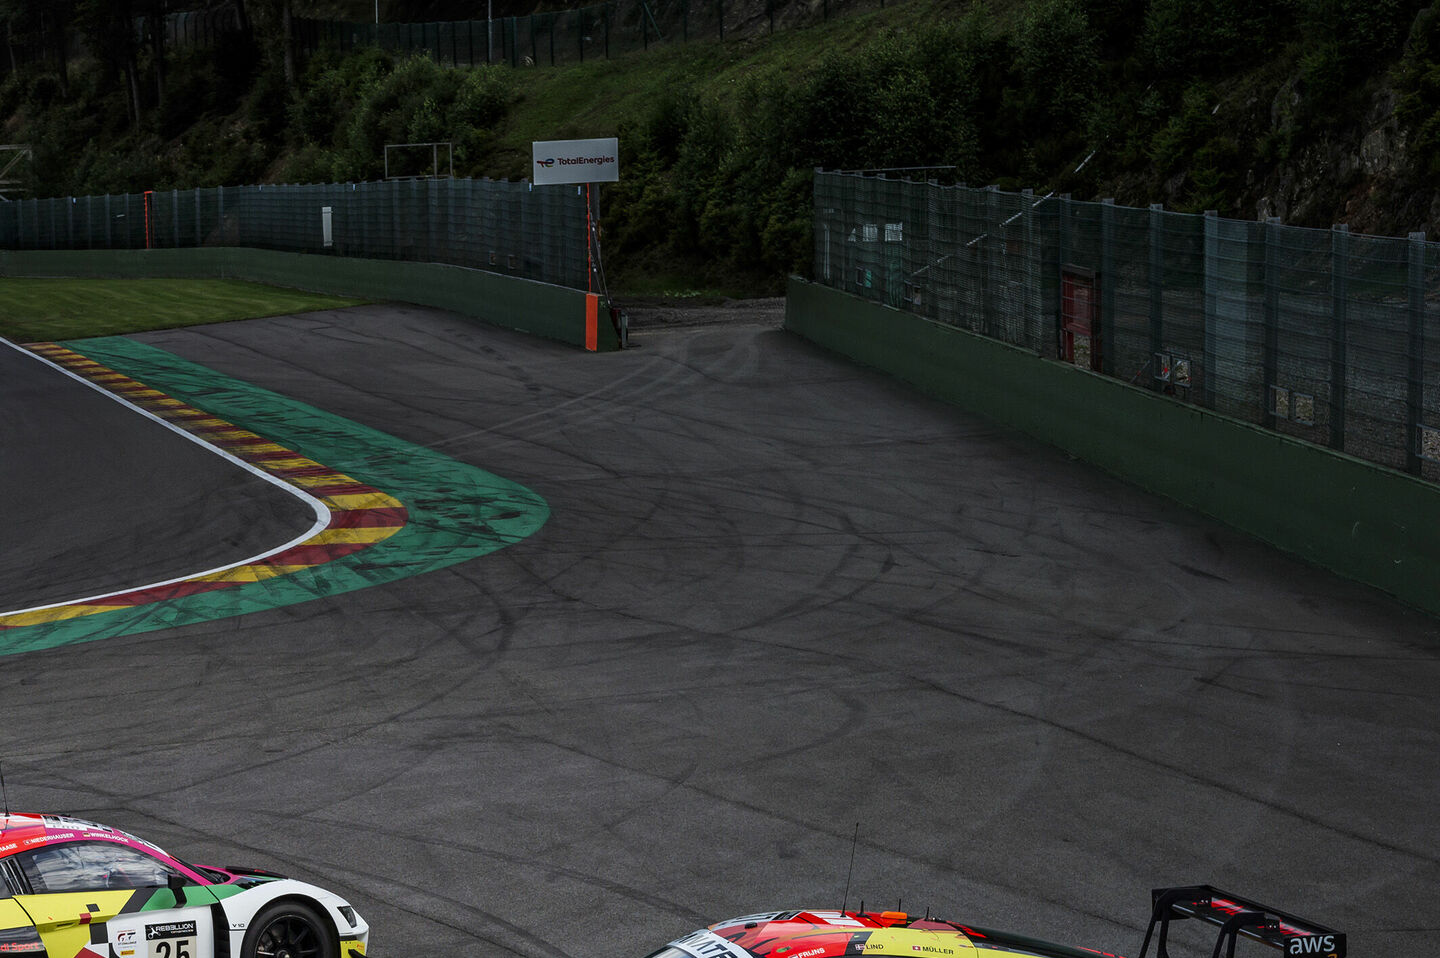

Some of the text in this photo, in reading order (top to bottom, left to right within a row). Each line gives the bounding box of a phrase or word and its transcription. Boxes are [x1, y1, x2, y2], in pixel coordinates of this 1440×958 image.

[557, 155, 615, 166] TotalEnergies
[12, 942, 40, 952] Sport
[922, 945, 954, 955] MÜLLER
[1289, 935, 1336, 955] aws
[798, 947, 826, 958] FRIJNS
